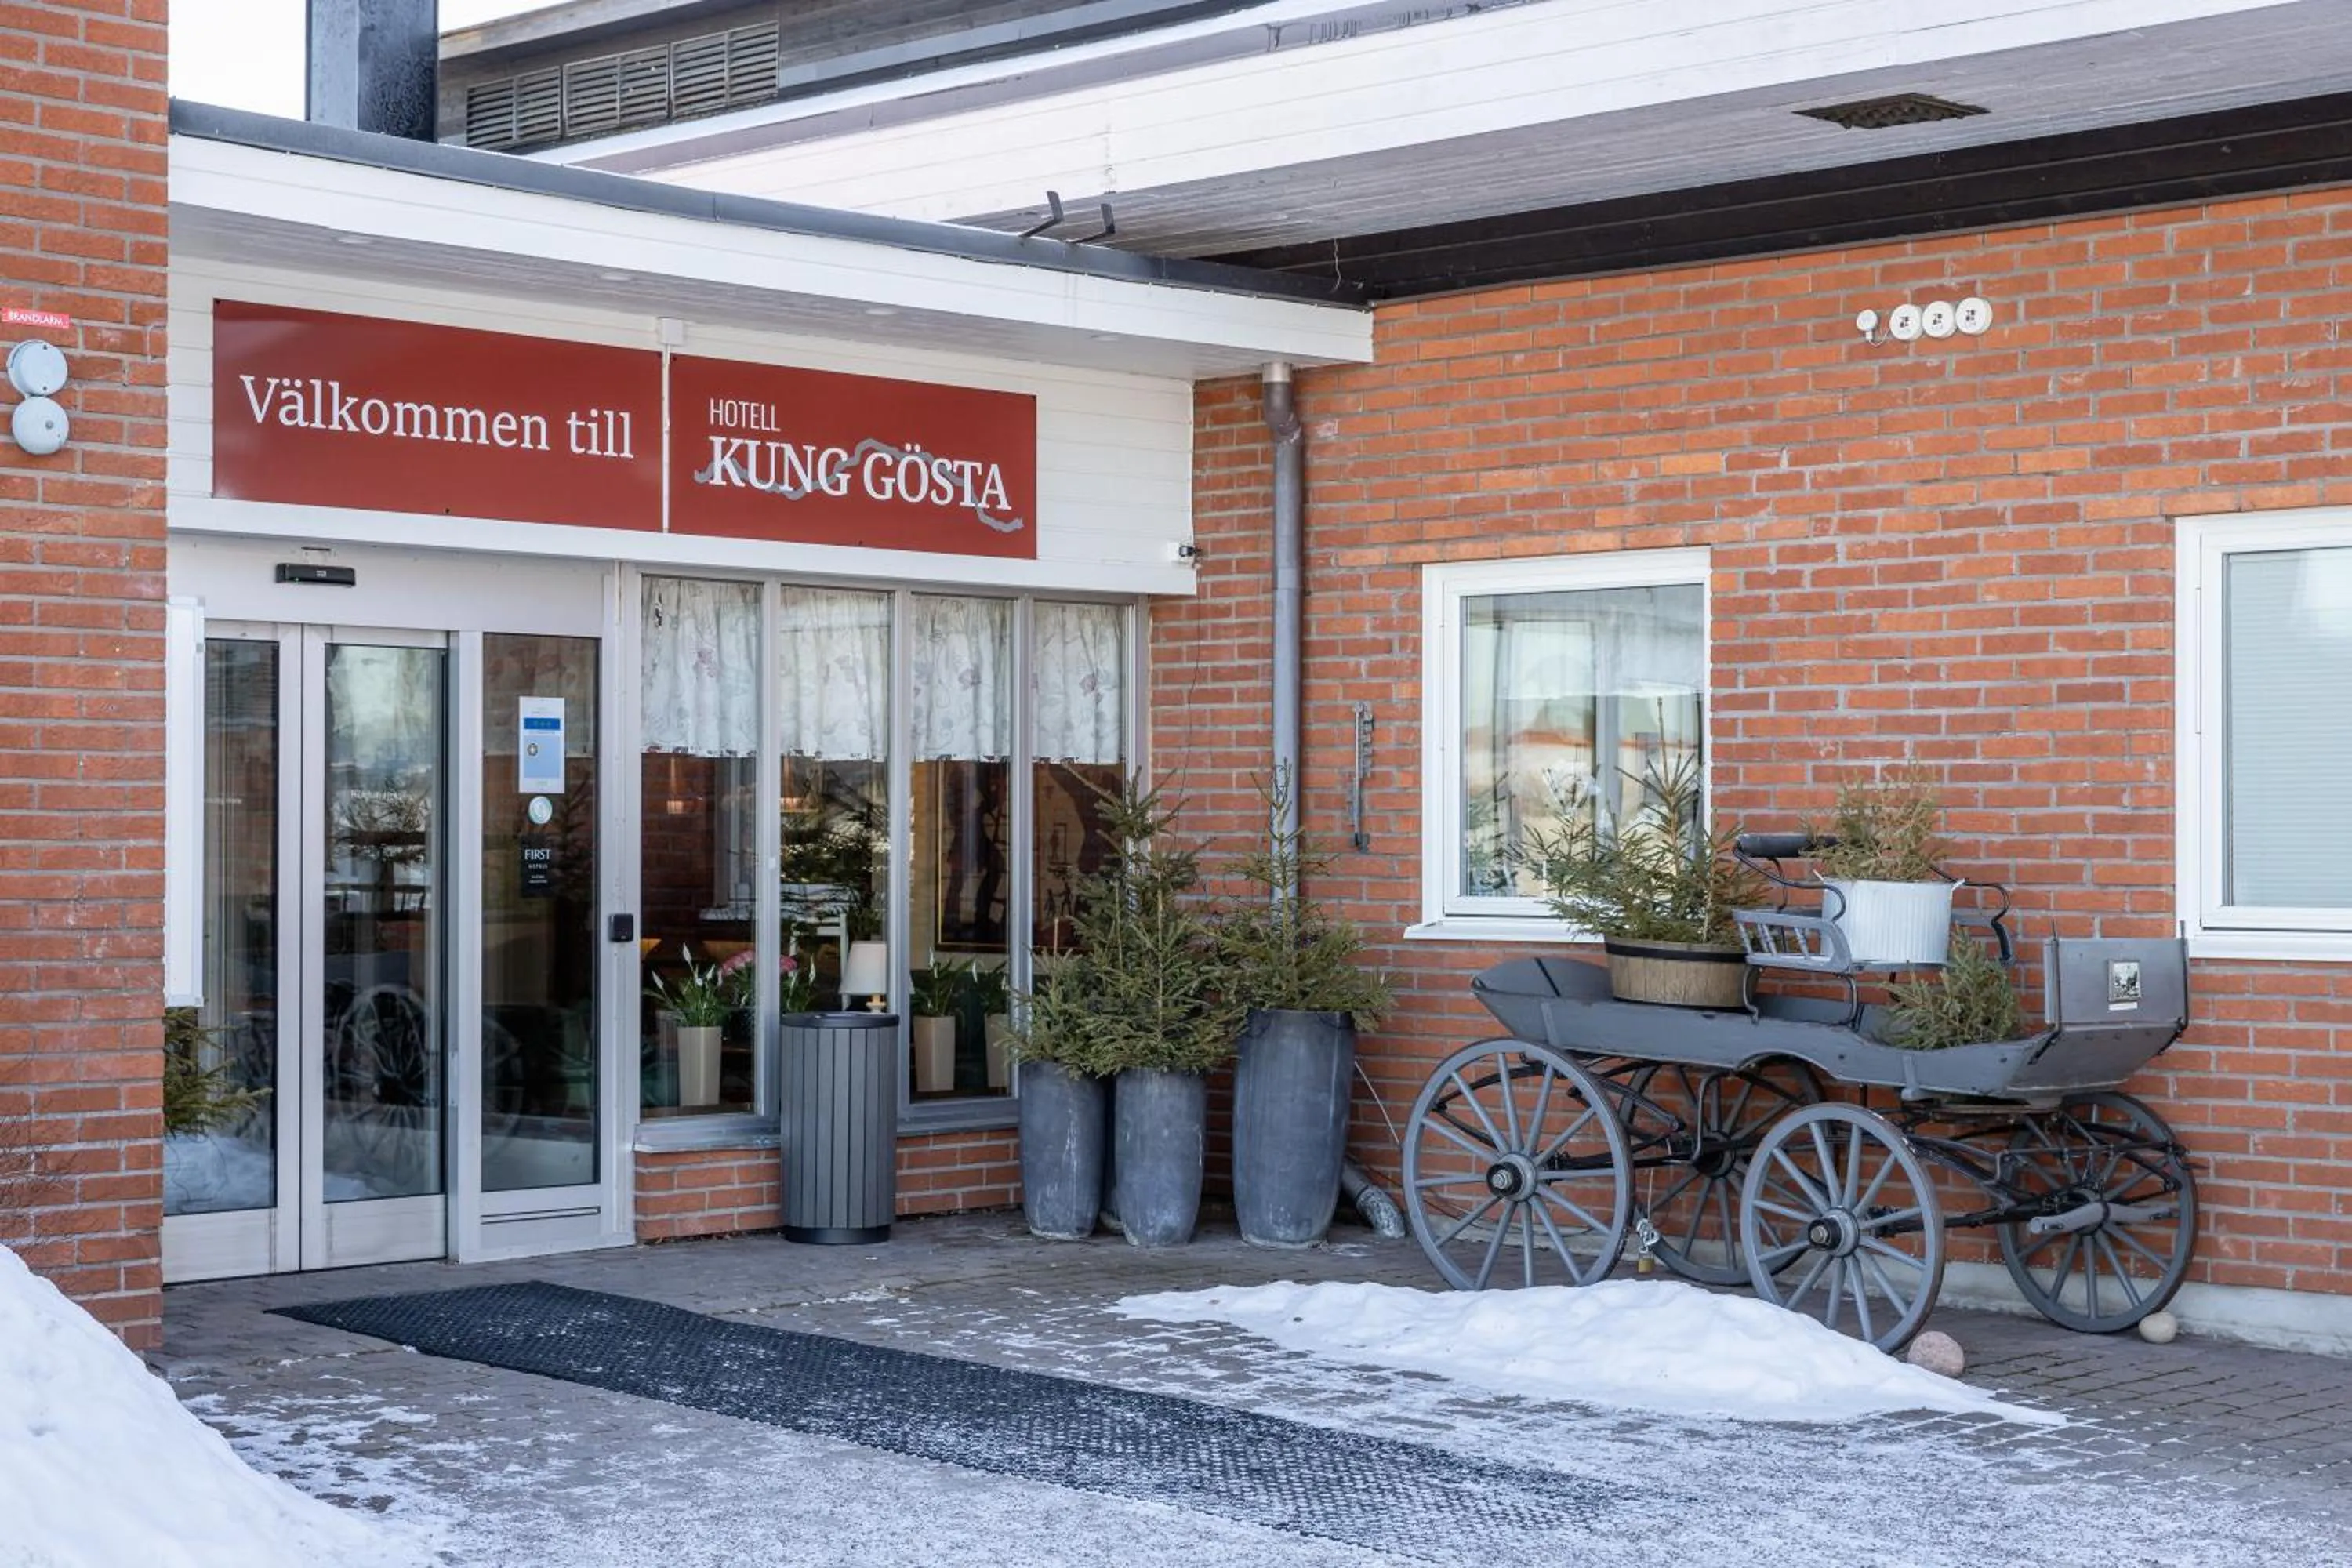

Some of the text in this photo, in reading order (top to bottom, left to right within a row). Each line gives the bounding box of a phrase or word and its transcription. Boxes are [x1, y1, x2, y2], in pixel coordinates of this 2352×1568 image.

[239, 375, 634, 459] Välkommen till
[710, 398, 781, 432] HOTELL
[709, 436, 1011, 510] KUNG GÖSTA
[524, 849, 550, 860] FIRST
